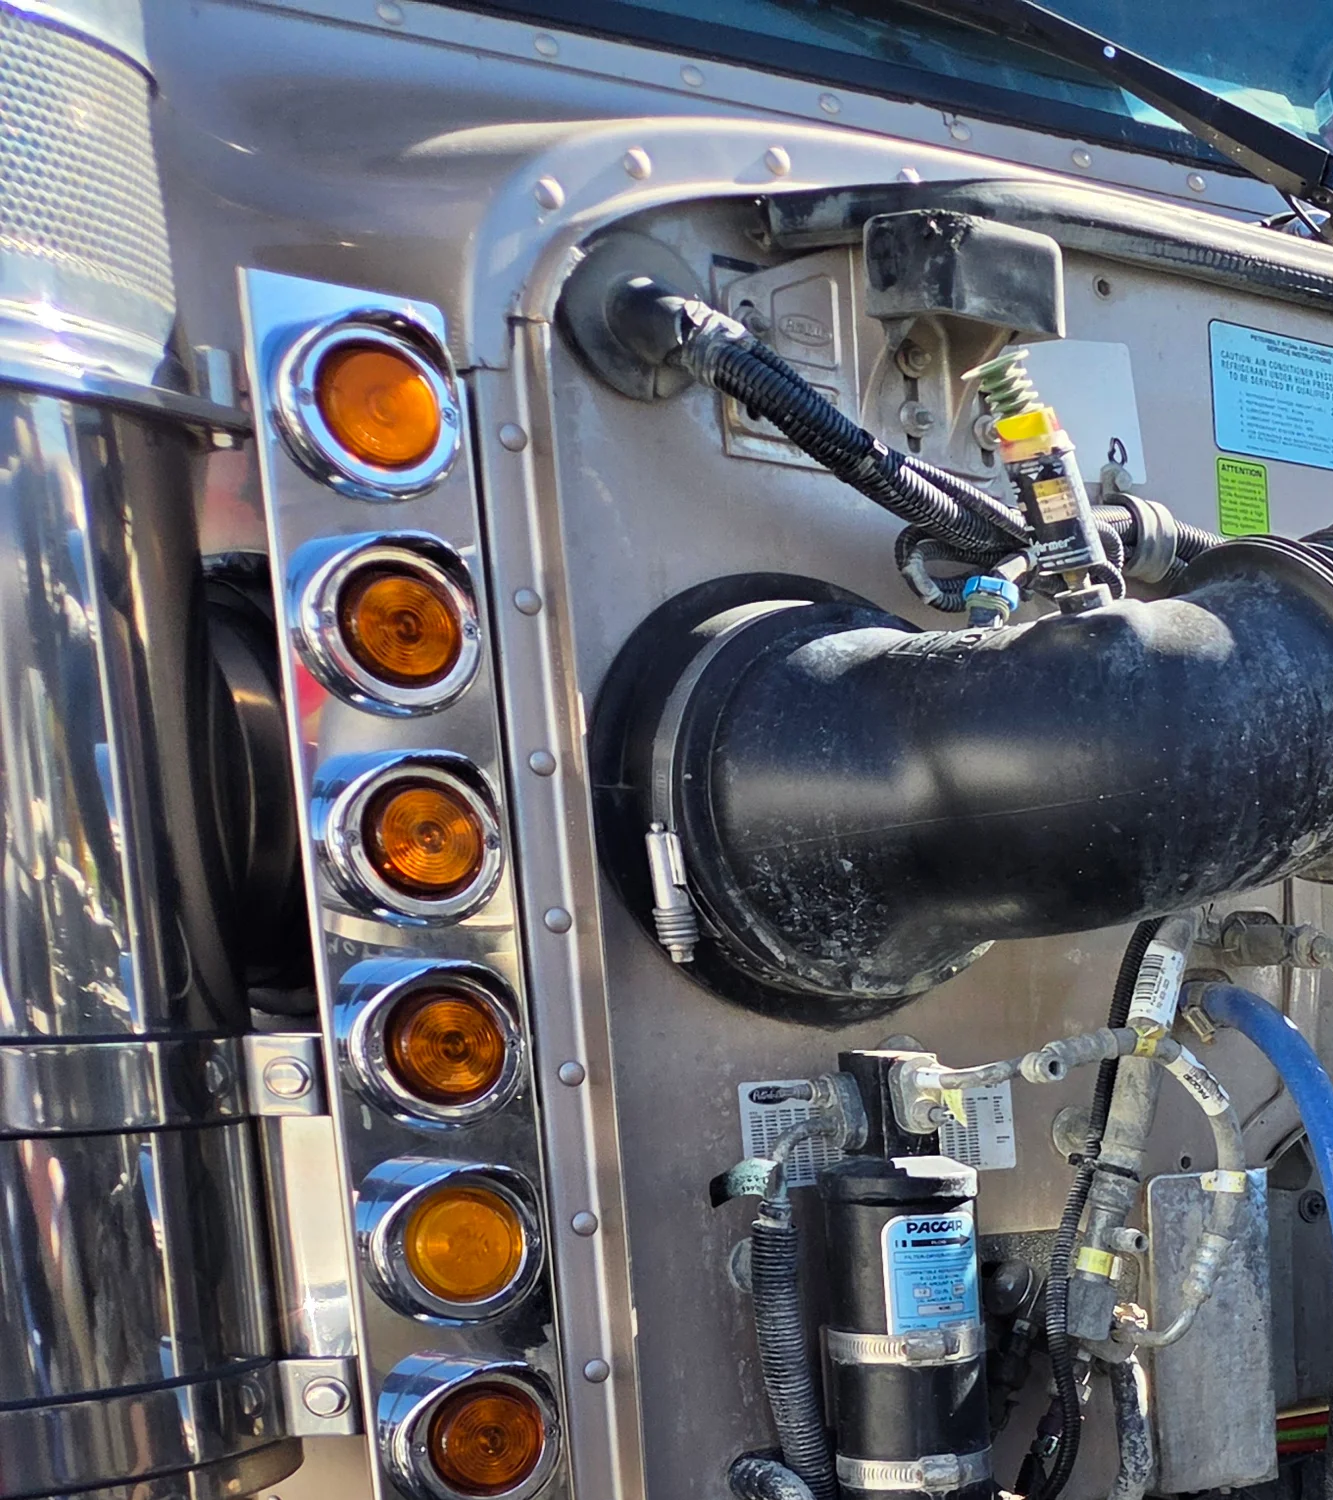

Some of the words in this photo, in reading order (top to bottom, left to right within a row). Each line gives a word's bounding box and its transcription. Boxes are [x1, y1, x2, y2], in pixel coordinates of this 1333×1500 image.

[1220, 359, 1268, 377] REFRIGERANT
[1269, 369, 1292, 382] UNDER
[1294, 374, 1311, 386] HIGH
[1255, 357, 1267, 367] AIR
[1268, 360, 1314, 377] CONDITIONER
[1229, 371, 1239, 381] TO
[1240, 373, 1249, 383] BE
[1250, 375, 1284, 391] SERVICED
[1286, 382, 1295, 393] BY
[1296, 387, 1331, 402] QUALIFIED
[1220, 463, 1263, 478] ATTENTION
[906, 1219, 963, 1235] PACCAR
